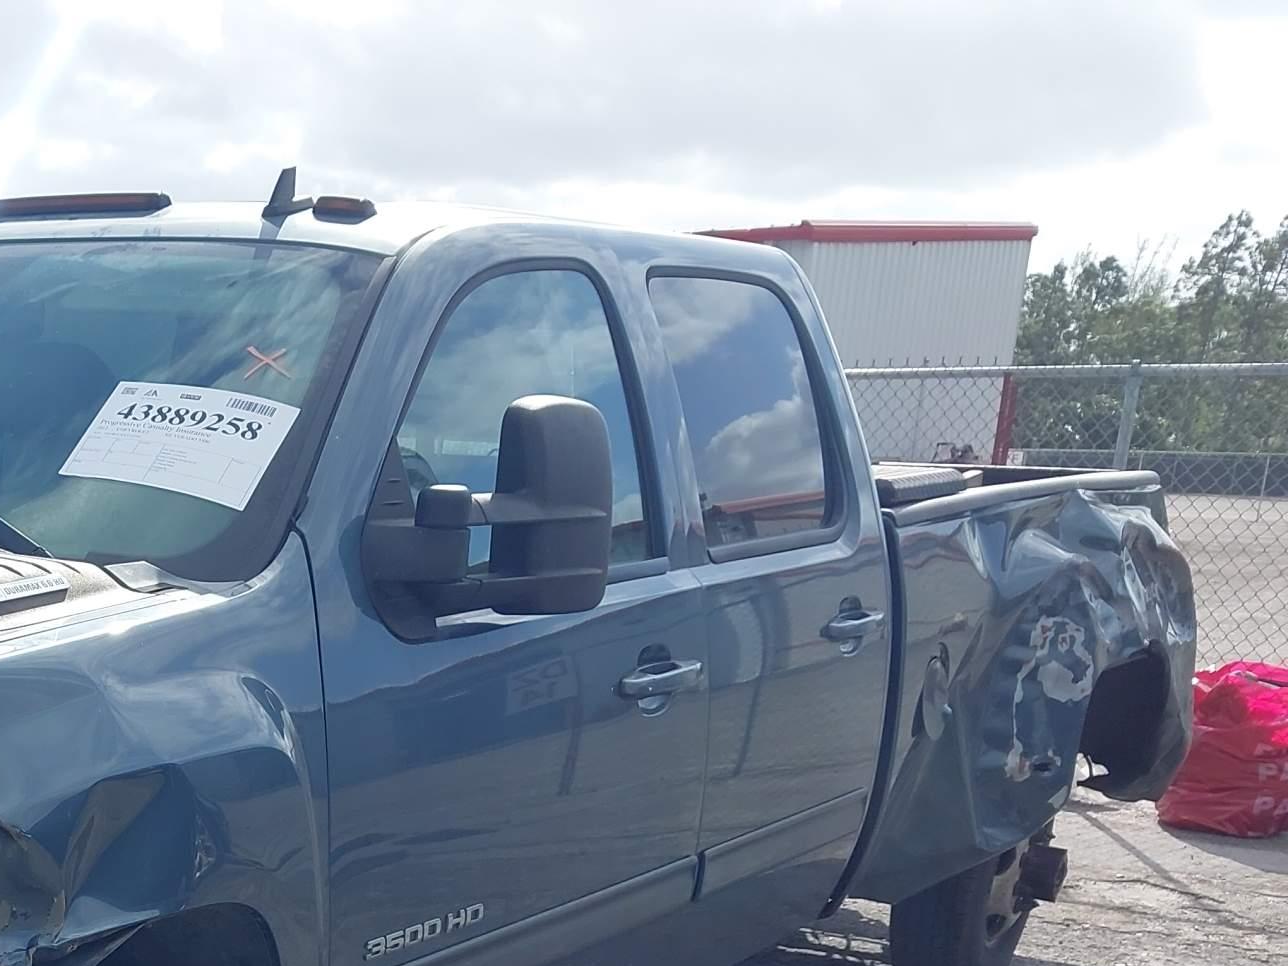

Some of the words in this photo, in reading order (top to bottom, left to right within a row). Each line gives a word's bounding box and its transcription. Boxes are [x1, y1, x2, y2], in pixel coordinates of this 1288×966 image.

[116, 402, 263, 441] 43889258
[143, 421, 174, 433] Casualty
[176, 427, 212, 438] Insurance
[3, 582, 41, 596] DURAMAX
[364, 917, 442, 961] 3500
[446, 903, 484, 934] HD
